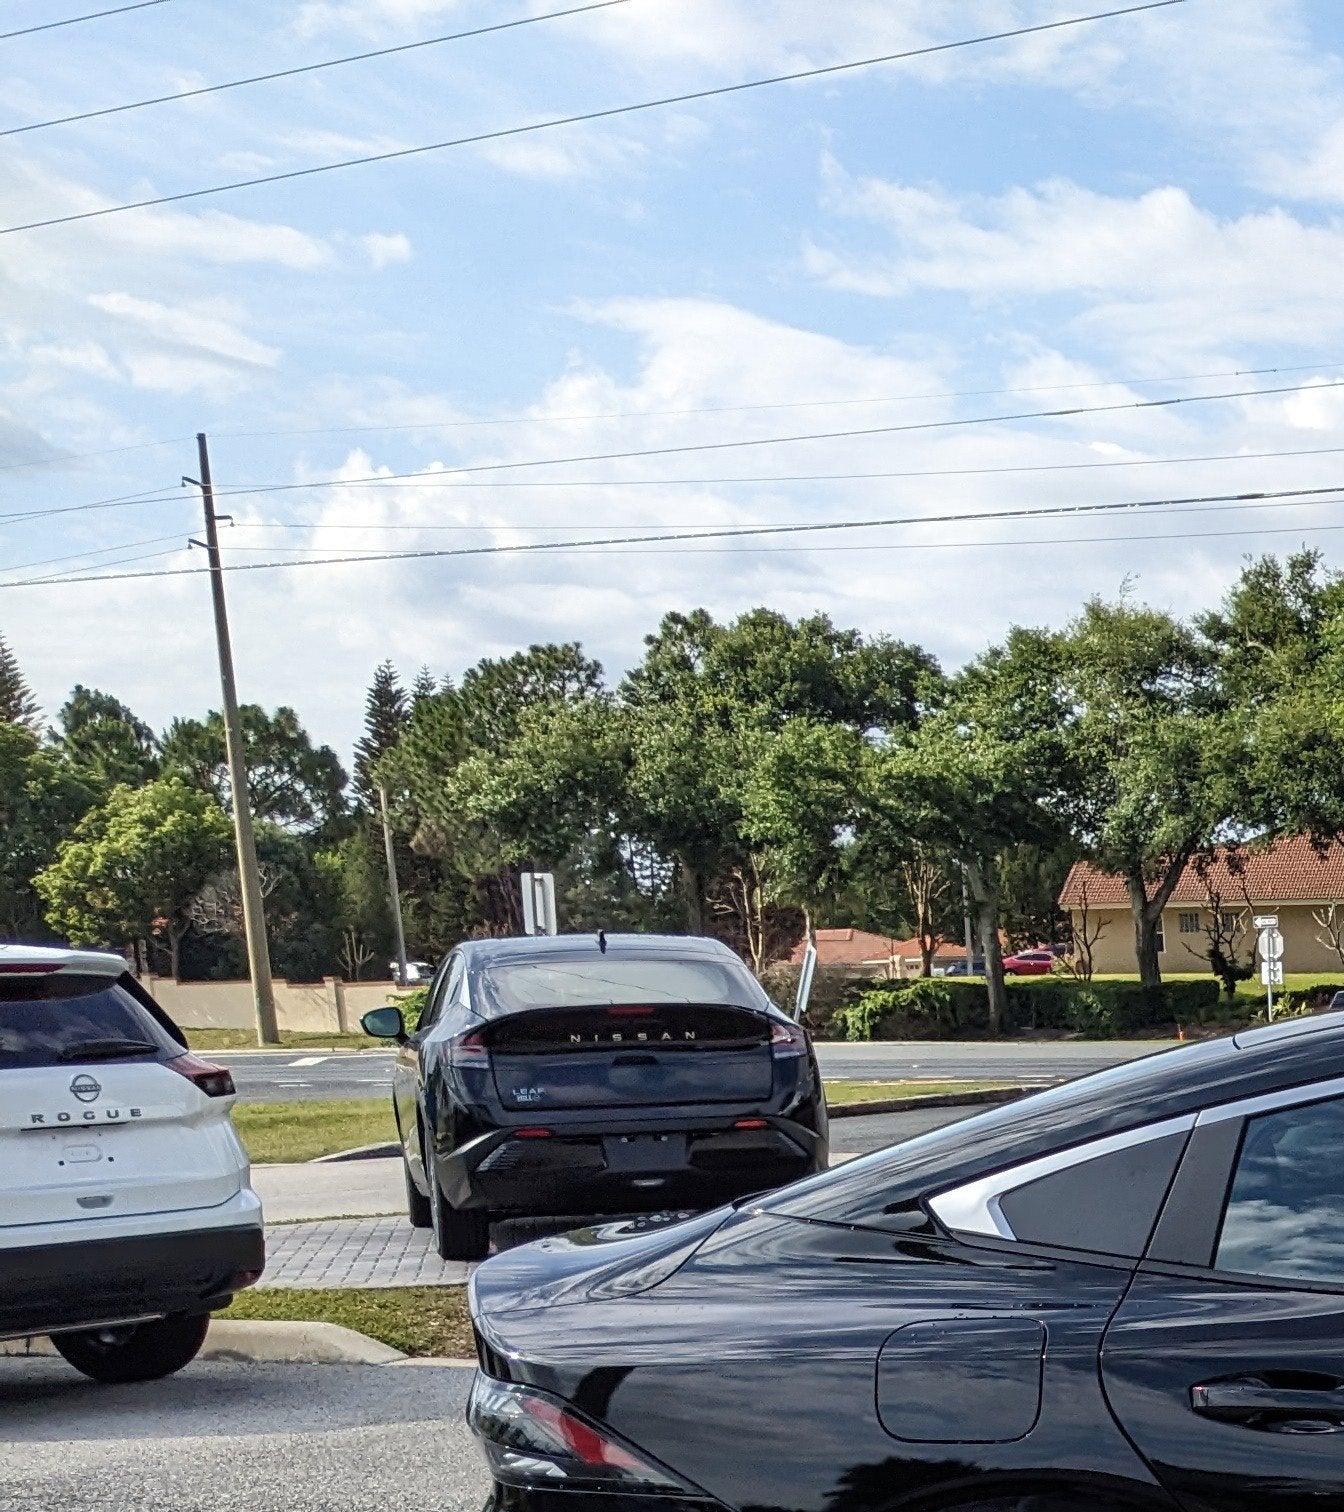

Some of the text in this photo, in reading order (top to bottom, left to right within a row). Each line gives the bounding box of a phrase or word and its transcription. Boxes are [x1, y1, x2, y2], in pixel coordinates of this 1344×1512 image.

[570, 1031, 695, 1044] NISSAN
[512, 1087, 545, 1096] LEAF
[30, 1108, 142, 1123] ROGUE
